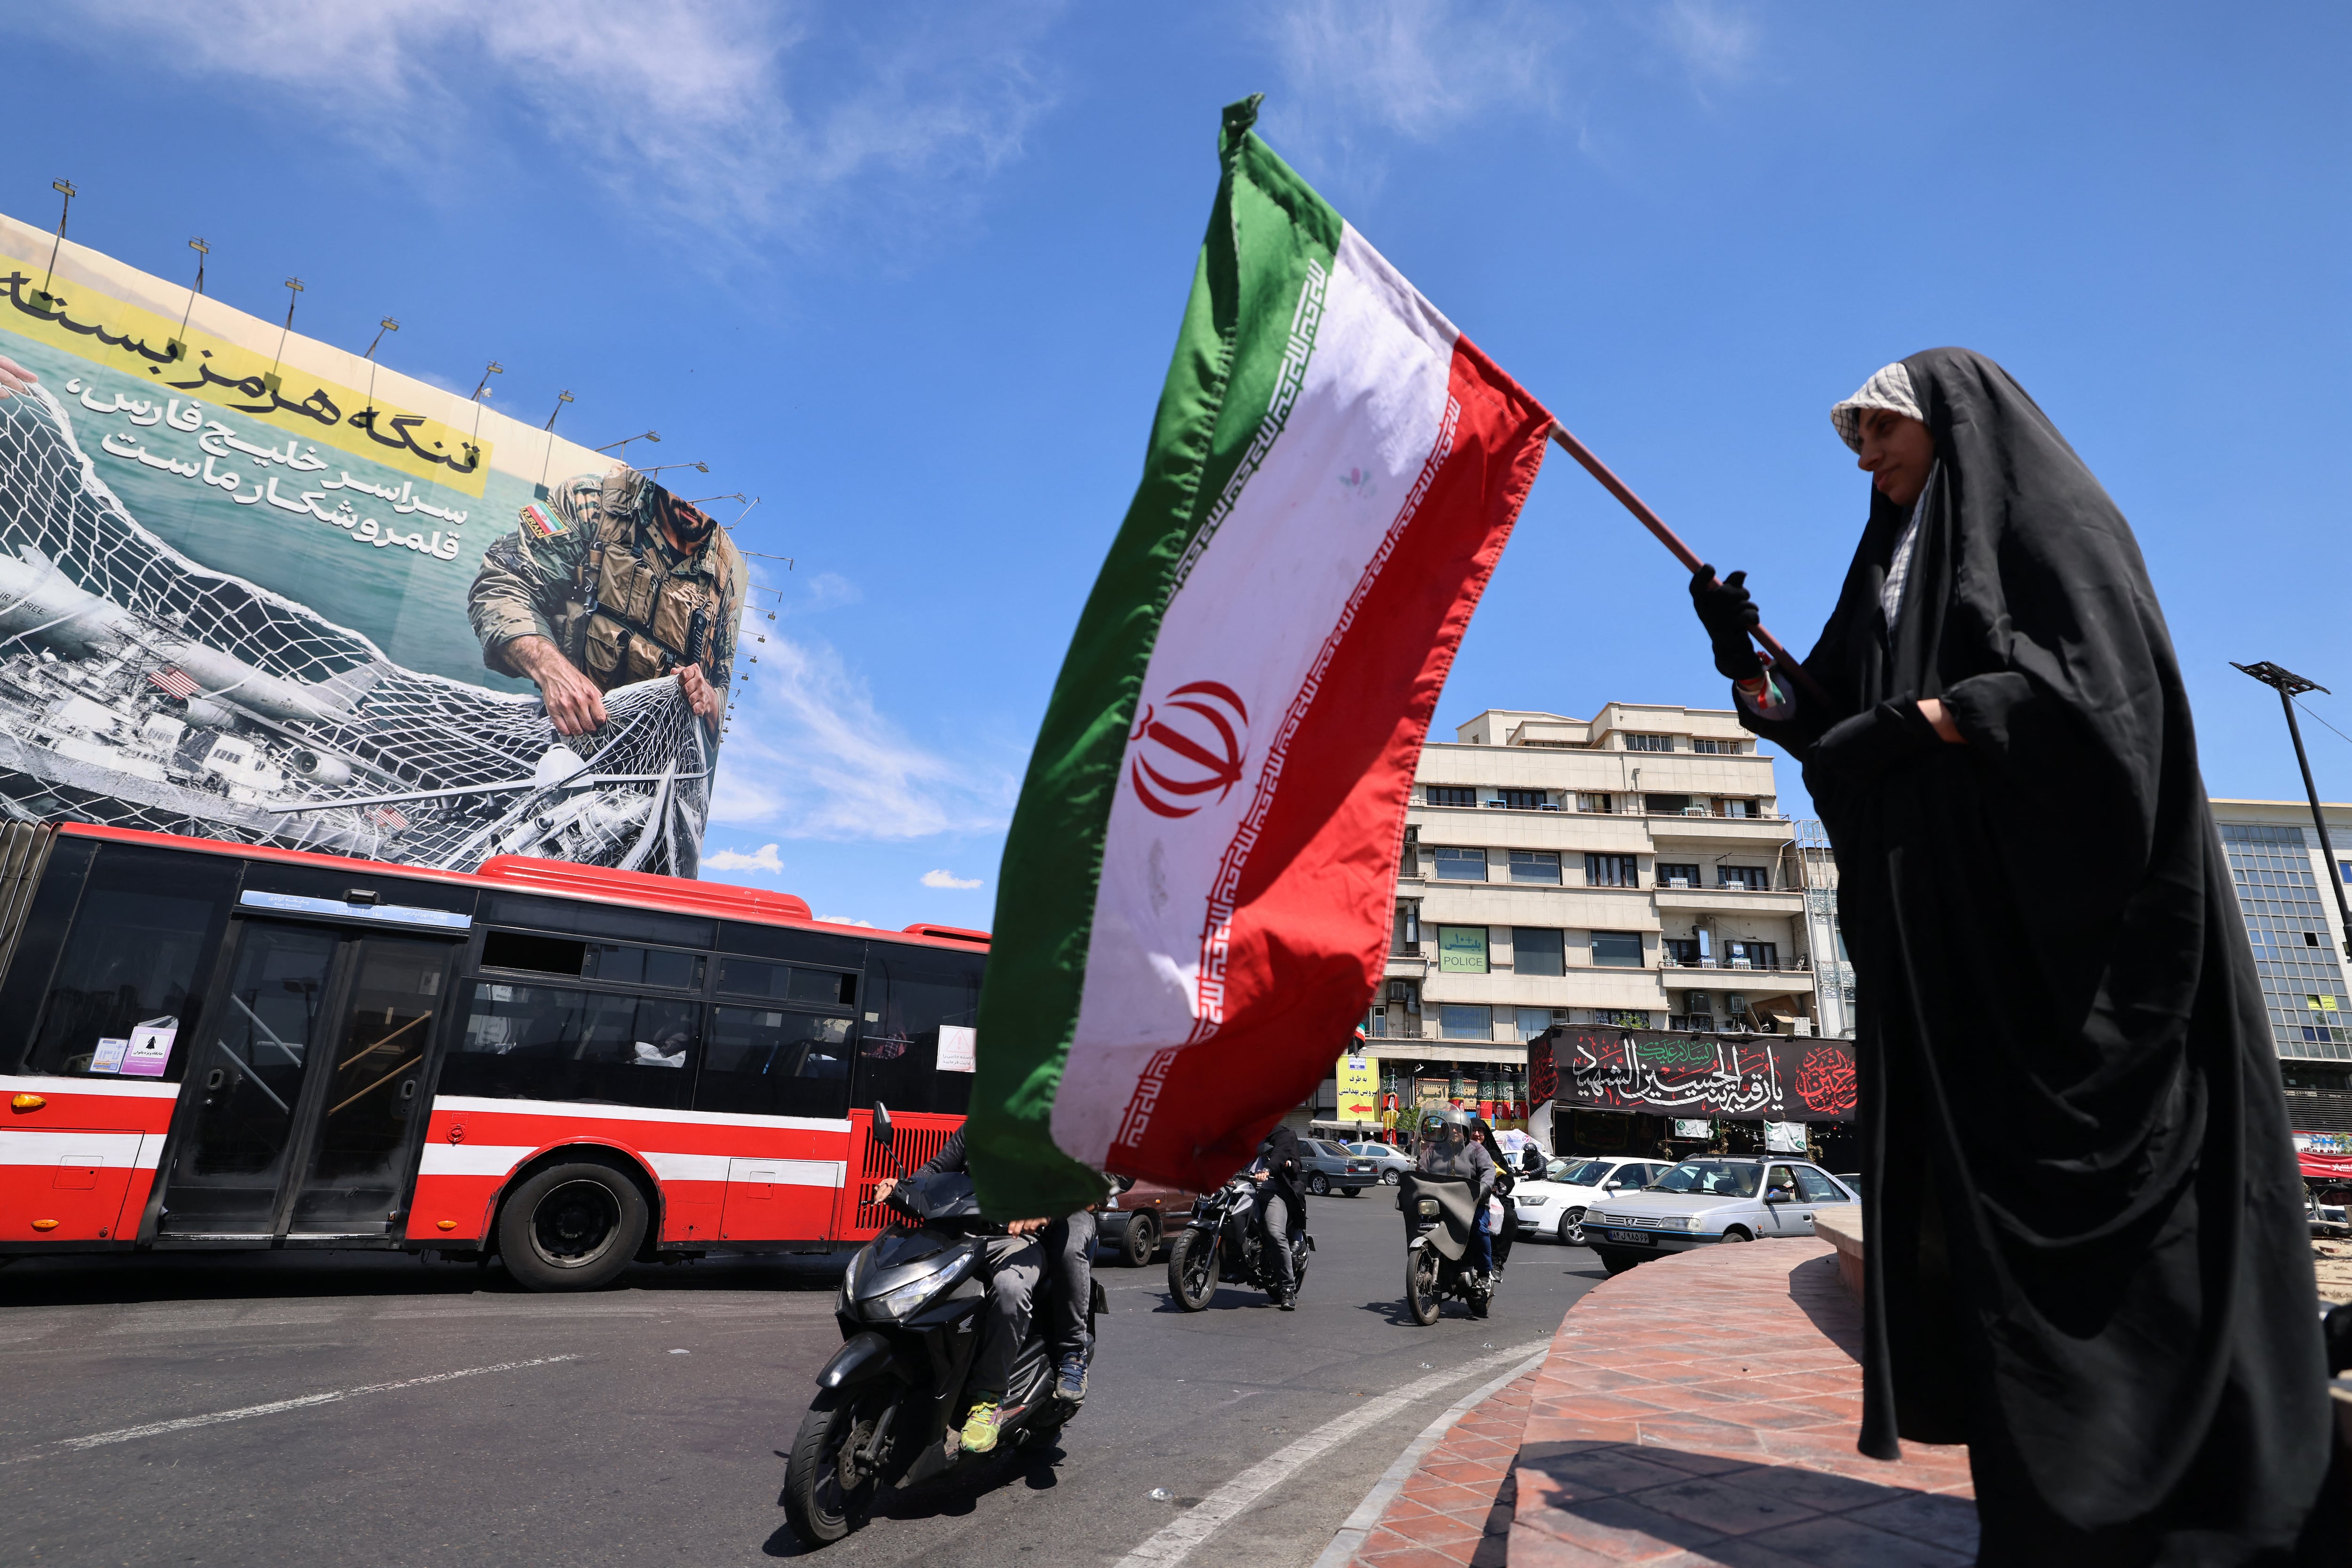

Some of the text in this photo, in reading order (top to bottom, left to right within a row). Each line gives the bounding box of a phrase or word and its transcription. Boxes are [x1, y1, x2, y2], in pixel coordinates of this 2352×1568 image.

[164, 350, 341, 425] هرمز
[199, 420, 328, 470] خلیج
[348, 406, 481, 473] تنگه
[101, 433, 461, 561] قلمرو شکار ماست
[320, 471, 468, 525] سراسر
[285, 897, 310, 906] پایانه
[1444, 956, 1483, 966] POLICE
[1445, 939, 1481, 952] پلیس
[98, 1050, 120, 1060] ۱۳۷
[1349, 1075, 1361, 1084] طرف
[1573, 1037, 1640, 1097] الشهید
[1618, 1042, 1743, 1098] الحسین
[1767, 1045, 1784, 1111] یا
[1339, 1087, 1359, 1096] بهداشتی
[1613, 1231, 1620, 1240] ۸۴
[1627, 1233, 1639, 1241] ۹۸۵
